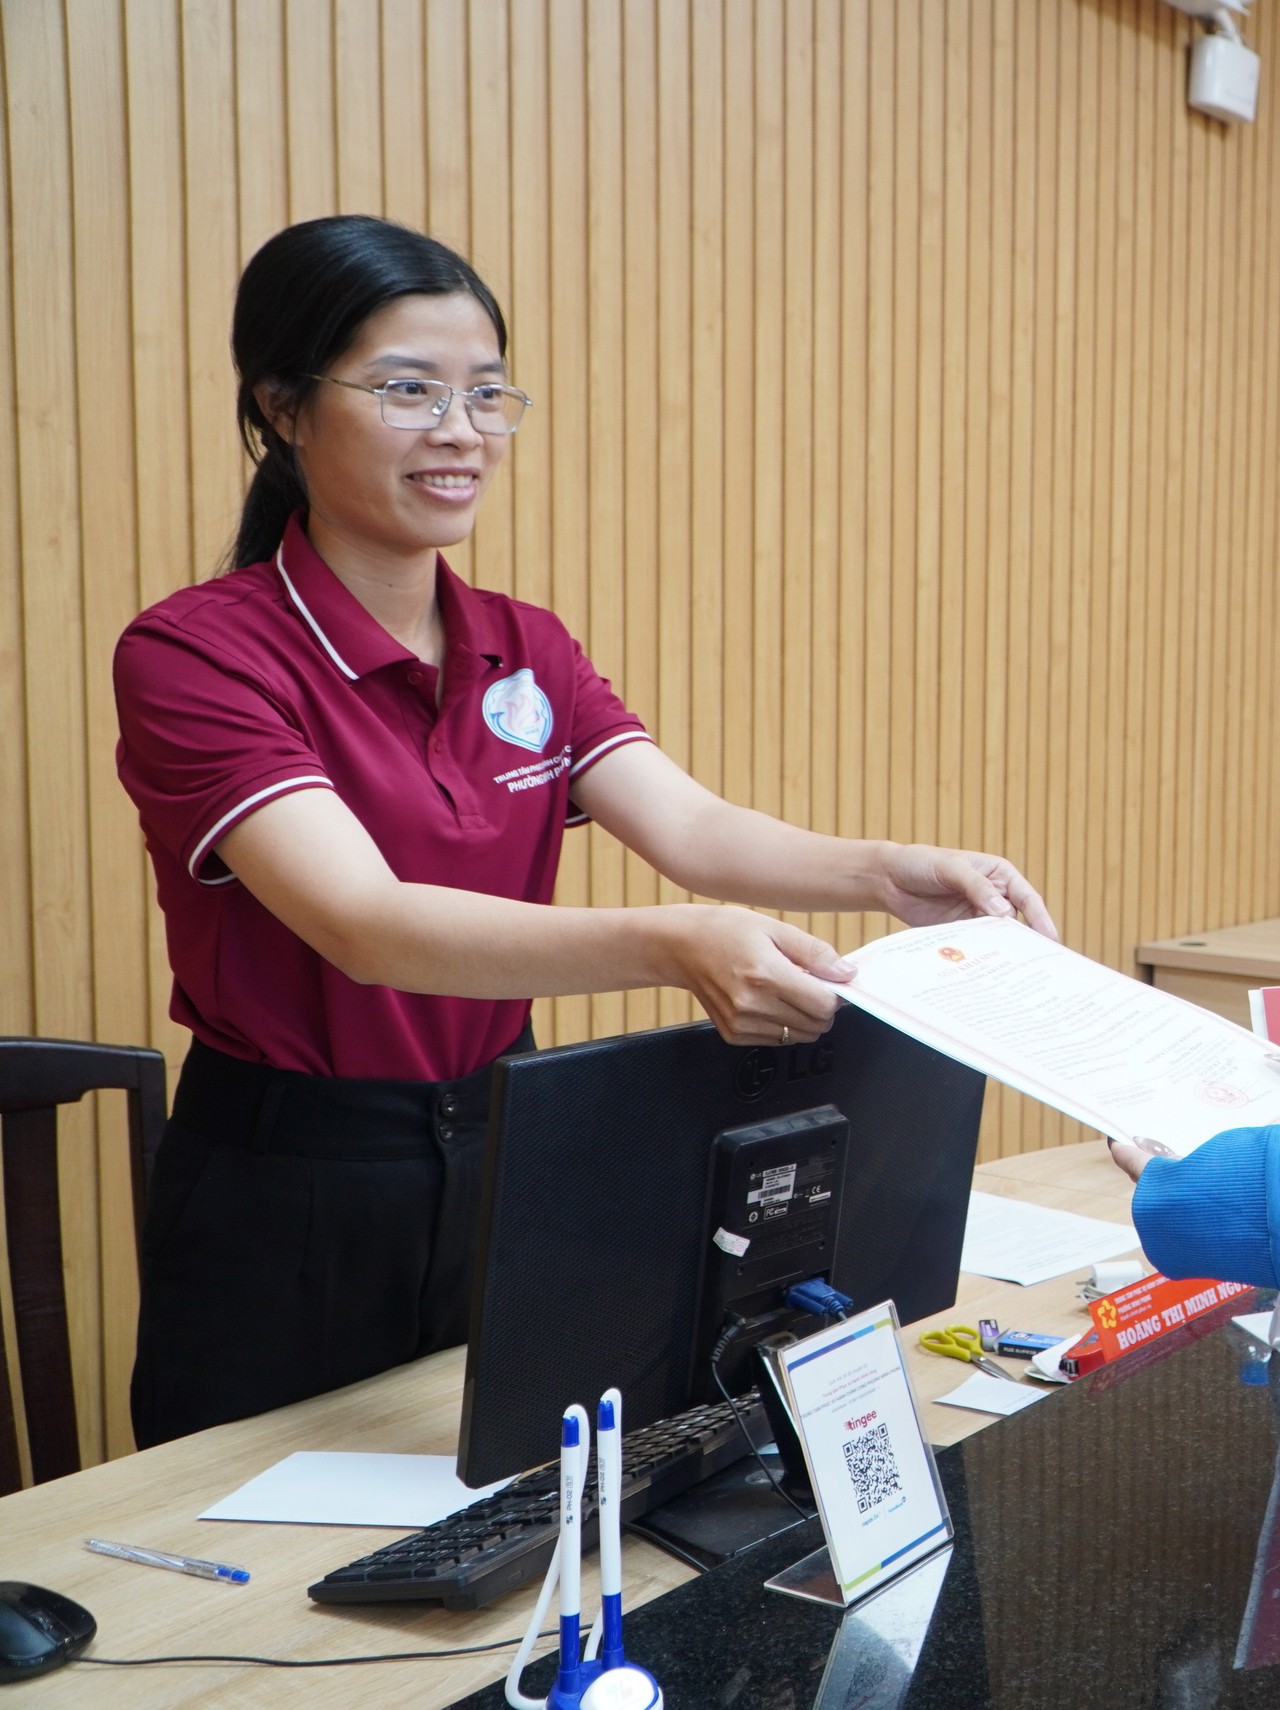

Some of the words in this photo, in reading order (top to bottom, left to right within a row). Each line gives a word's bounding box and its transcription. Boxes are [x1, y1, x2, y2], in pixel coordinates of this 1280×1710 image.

[1117, 1315, 1161, 1350] HOÀNG
[1161, 1303, 1187, 1328] THỊ
[1183, 1287, 1219, 1317] MINH
[845, 1410, 877, 1430] tingee
